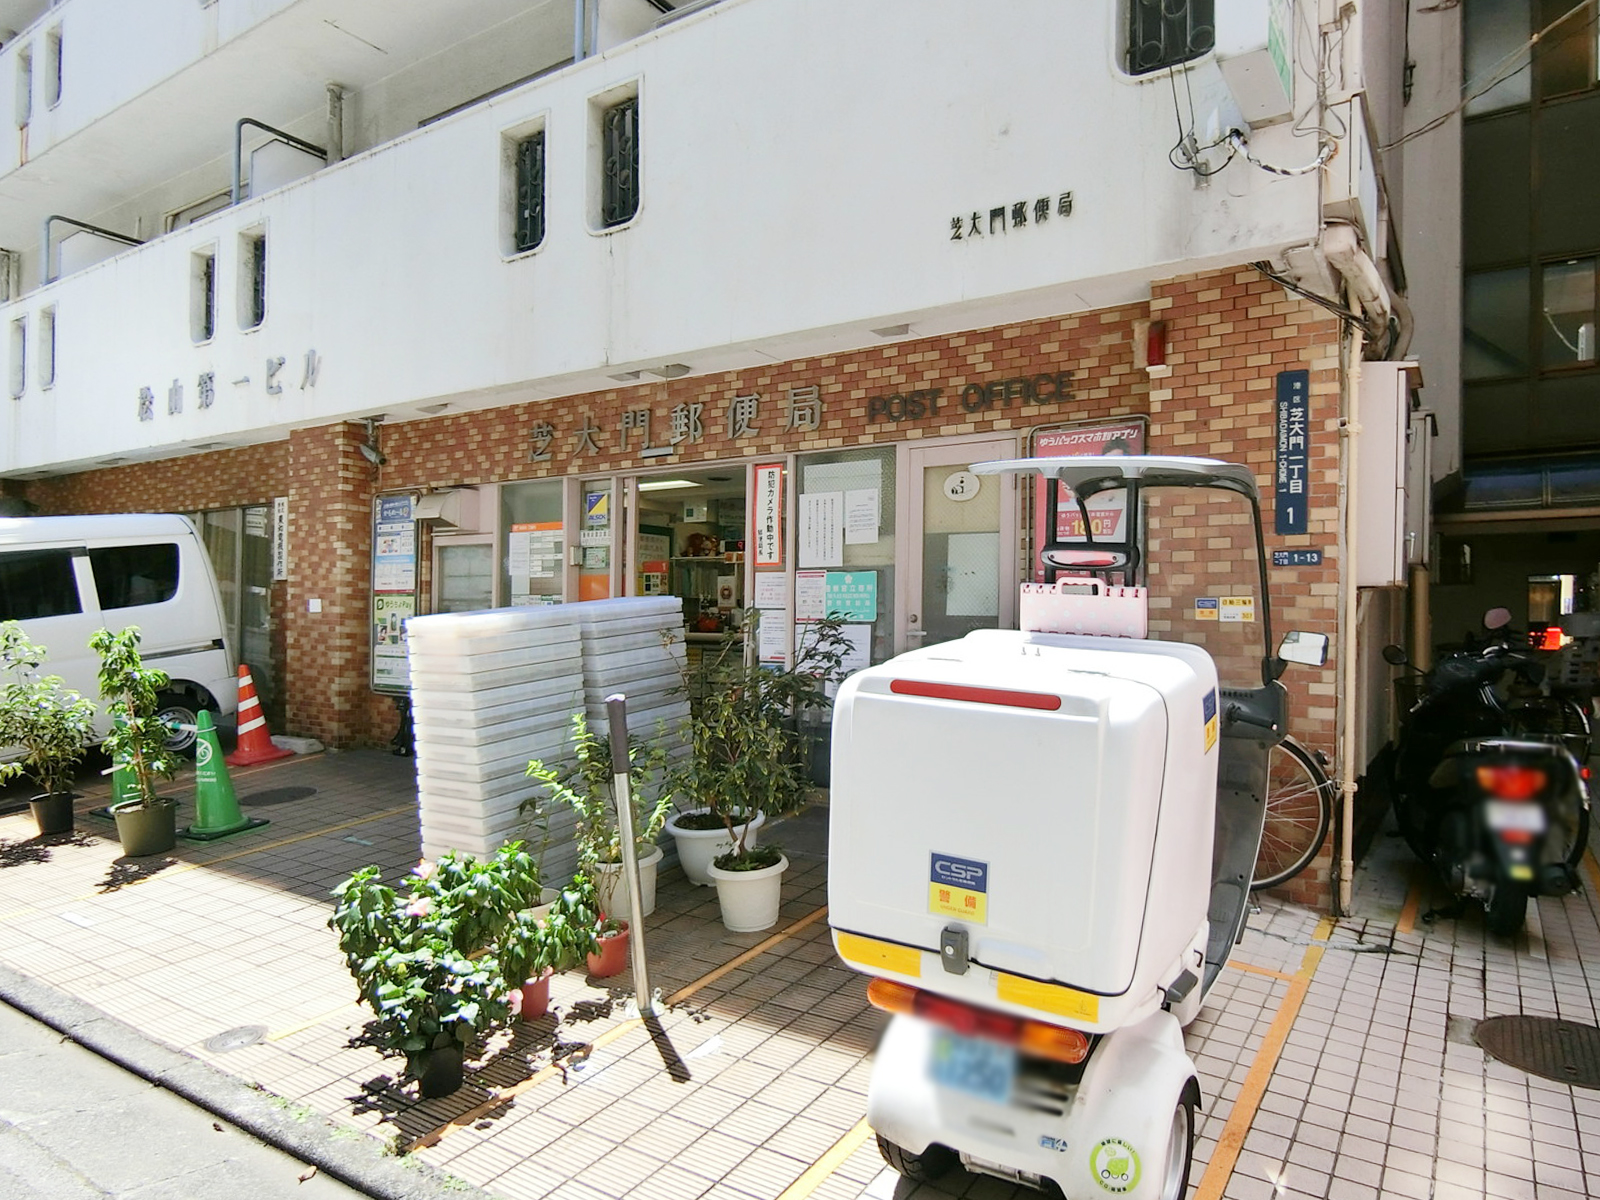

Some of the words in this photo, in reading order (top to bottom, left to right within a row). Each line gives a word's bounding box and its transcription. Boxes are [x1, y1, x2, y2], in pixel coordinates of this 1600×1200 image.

[949, 190, 1073, 241] 芝大門郵便局
[867, 387, 943, 423] POST
[961, 370, 1076, 413] OFFICE
[527, 384, 823, 462] 芝大門郵便局
[1279, 401, 1288, 452] SHIBADAIMON
[1278, 454, 1287, 484] 1-CHOME
[1289, 407, 1305, 494] 芝大門一丁目
[766, 470, 776, 560] 防犯カメラ作動中です
[1286, 506, 1294, 525] 1
[1293, 552, 1319, 563] 1-13
[934, 860, 983, 880] CSP
